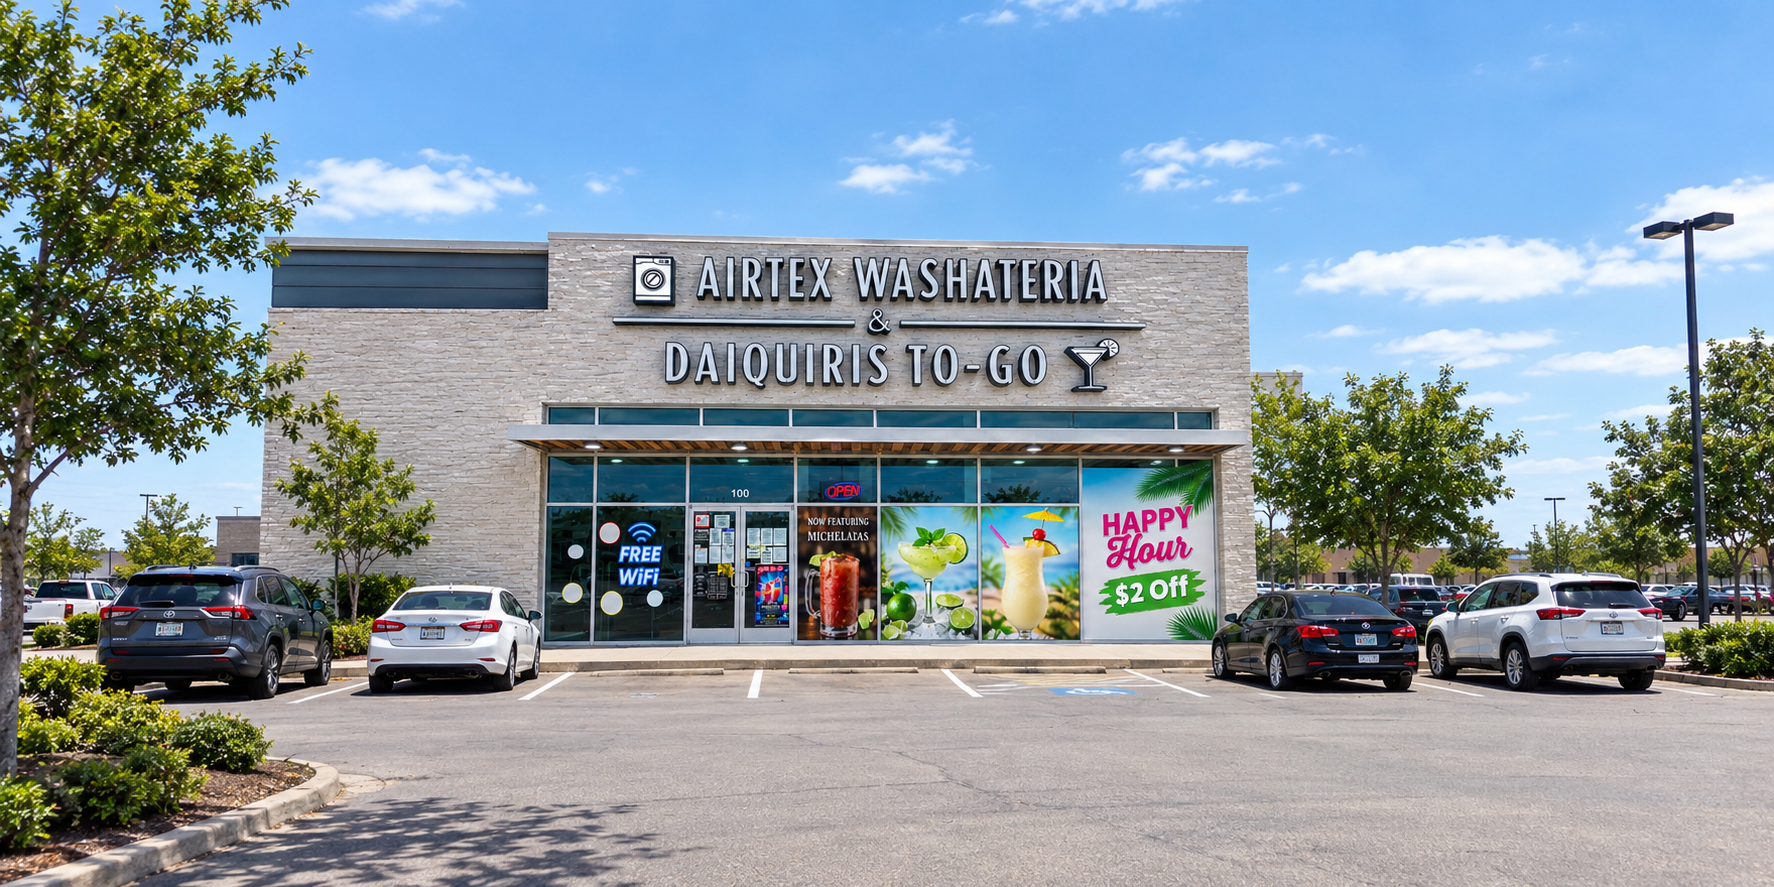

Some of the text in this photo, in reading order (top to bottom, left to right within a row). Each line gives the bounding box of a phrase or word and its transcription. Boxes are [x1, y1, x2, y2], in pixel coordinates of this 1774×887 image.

[696, 256, 1108, 304] AIRTEX WASHATERIA
[867, 308, 891, 335] &
[664, 341, 1048, 390] DAIQUIRIS TO-GO
[731, 489, 750, 498] 100
[826, 485, 860, 498] OPEN
[807, 517, 869, 526] NOW FEATURING
[1102, 505, 1194, 537] HAPPY
[618, 545, 663, 563] FREE
[1106, 533, 1194, 571] Hour
[619, 567, 660, 586] WiFi
[1115, 574, 1188, 607] $2 Off
